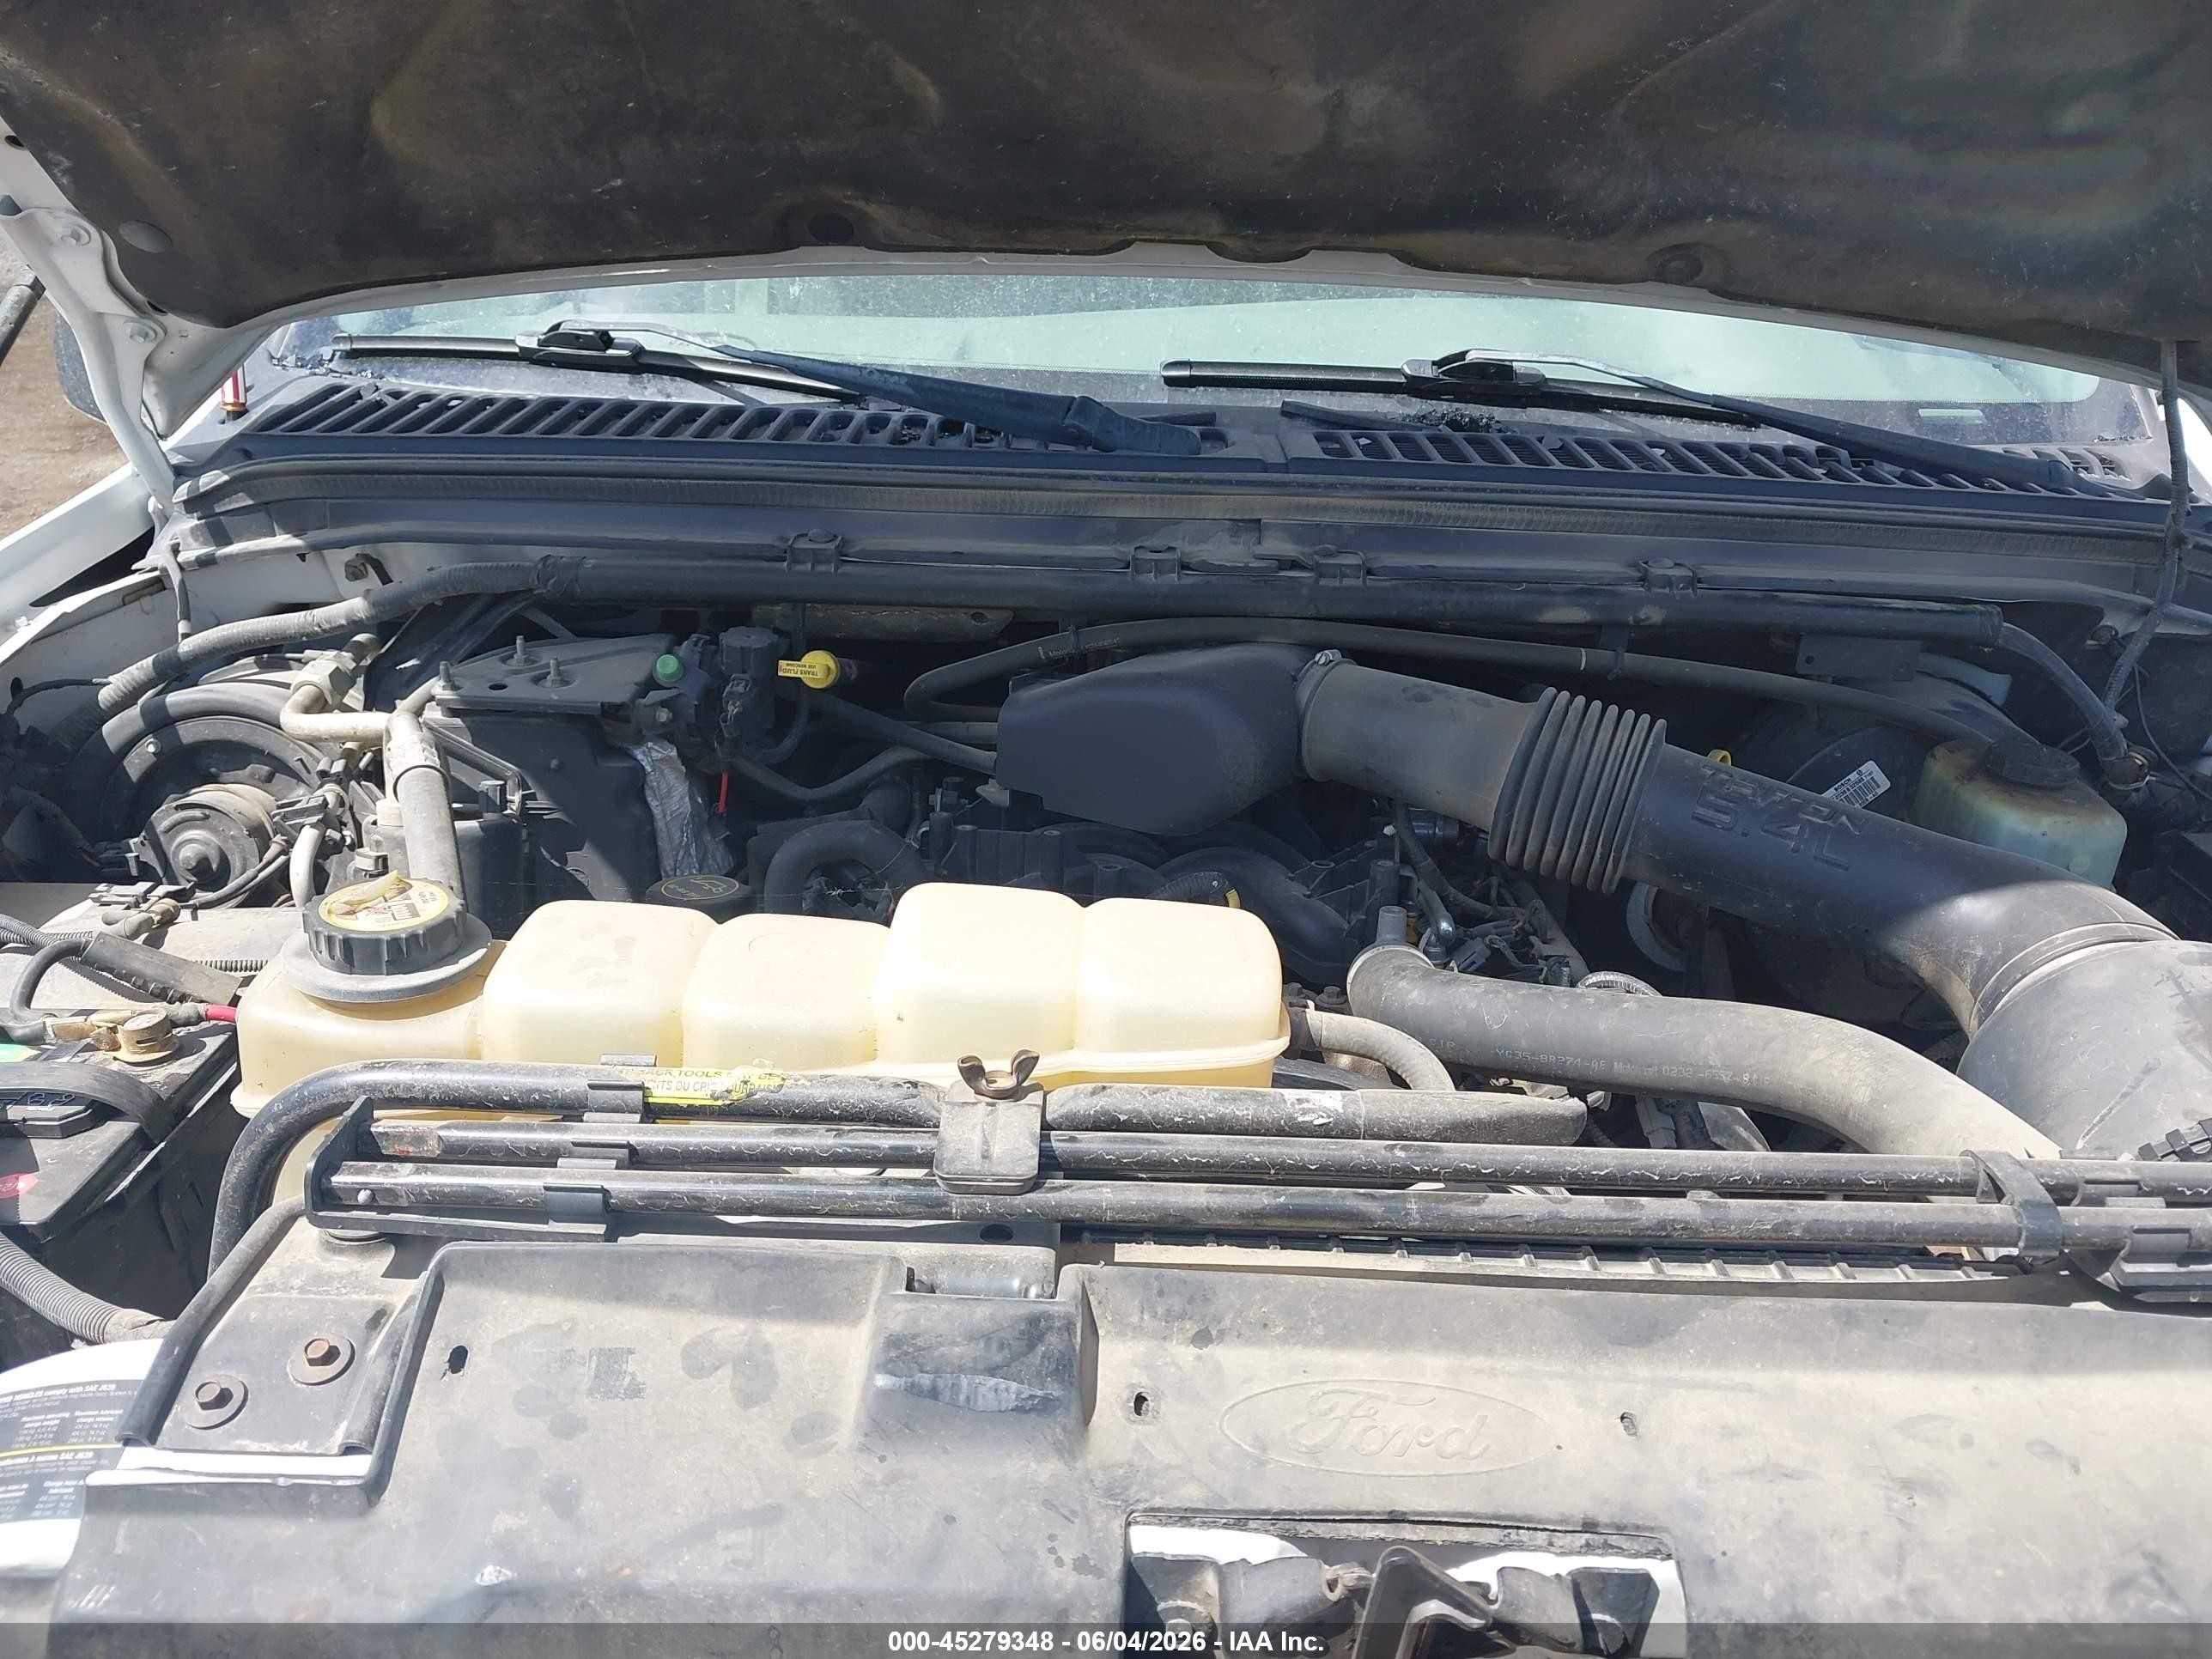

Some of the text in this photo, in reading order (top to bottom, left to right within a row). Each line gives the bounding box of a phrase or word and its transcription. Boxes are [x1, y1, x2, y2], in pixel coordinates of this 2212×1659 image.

[799, 666, 818, 677] TRANS
[1833, 777, 1852, 793] BOSCH
[1700, 763, 1872, 836] TRITON
[675, 1069, 723, 1078] TOOLS
[675, 1081, 692, 1091] DU
[44, 1387, 67, 1397] comply
[68, 1385, 83, 1394] with
[98, 1382, 117, 1391] J639
[1289, 1388, 1491, 1460] Ford
[59, 1452, 76, 1461] SAE
[74, 1450, 94, 1460] J639
